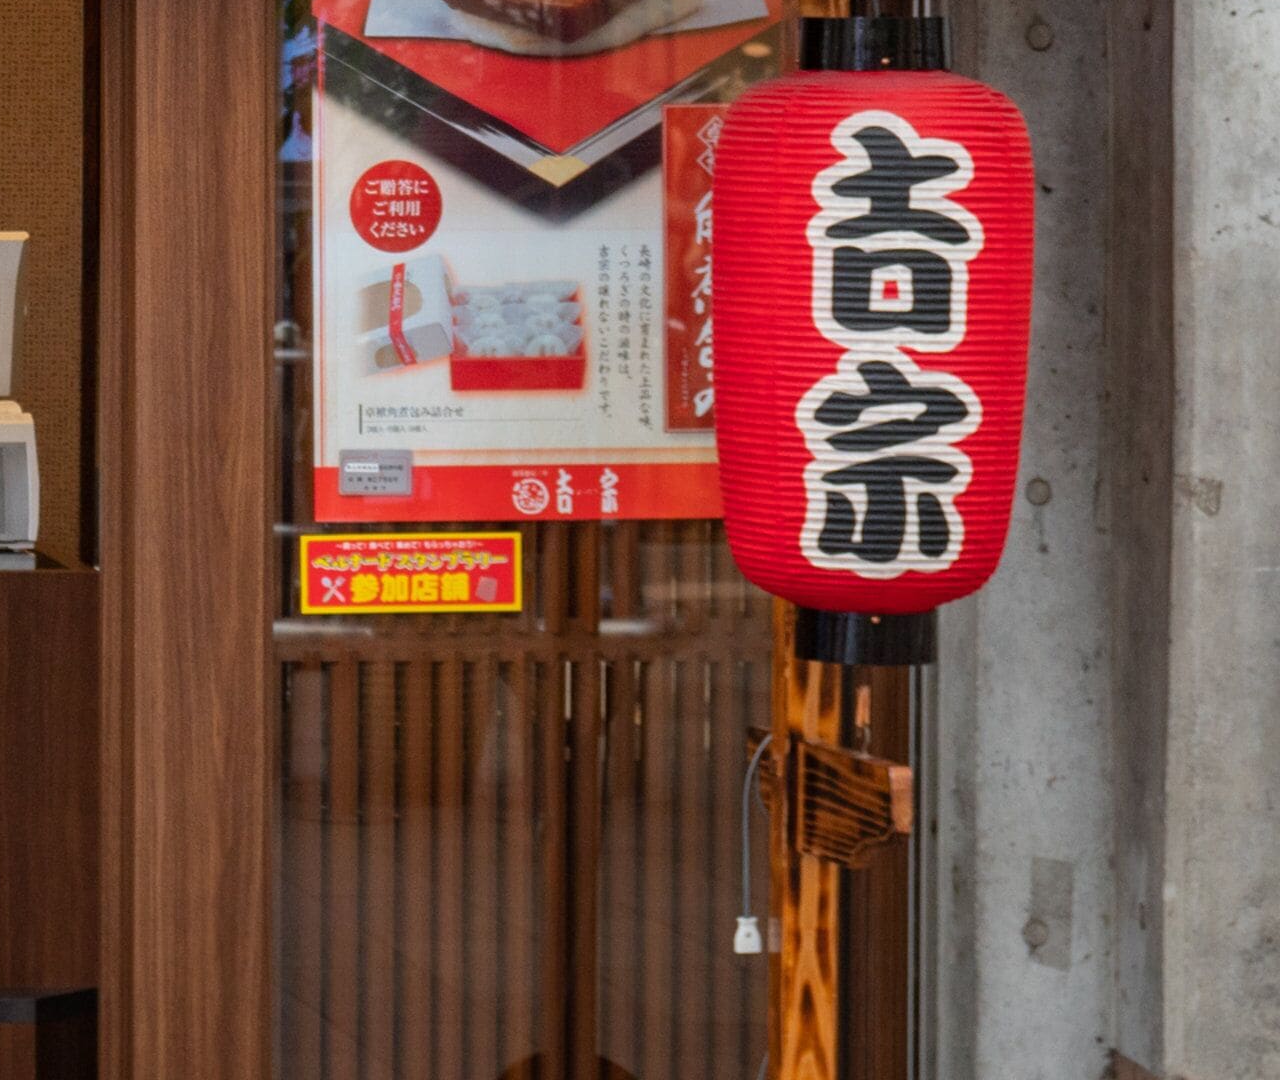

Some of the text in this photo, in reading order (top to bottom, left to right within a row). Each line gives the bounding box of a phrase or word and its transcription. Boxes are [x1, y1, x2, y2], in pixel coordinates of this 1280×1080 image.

[364, 178, 429, 196] ご贈答に
[373, 201, 421, 217] ご利用
[368, 223, 425, 238] ください
[810, 122, 974, 566] 吉宗
[349, 572, 471, 603] 参加店舗
